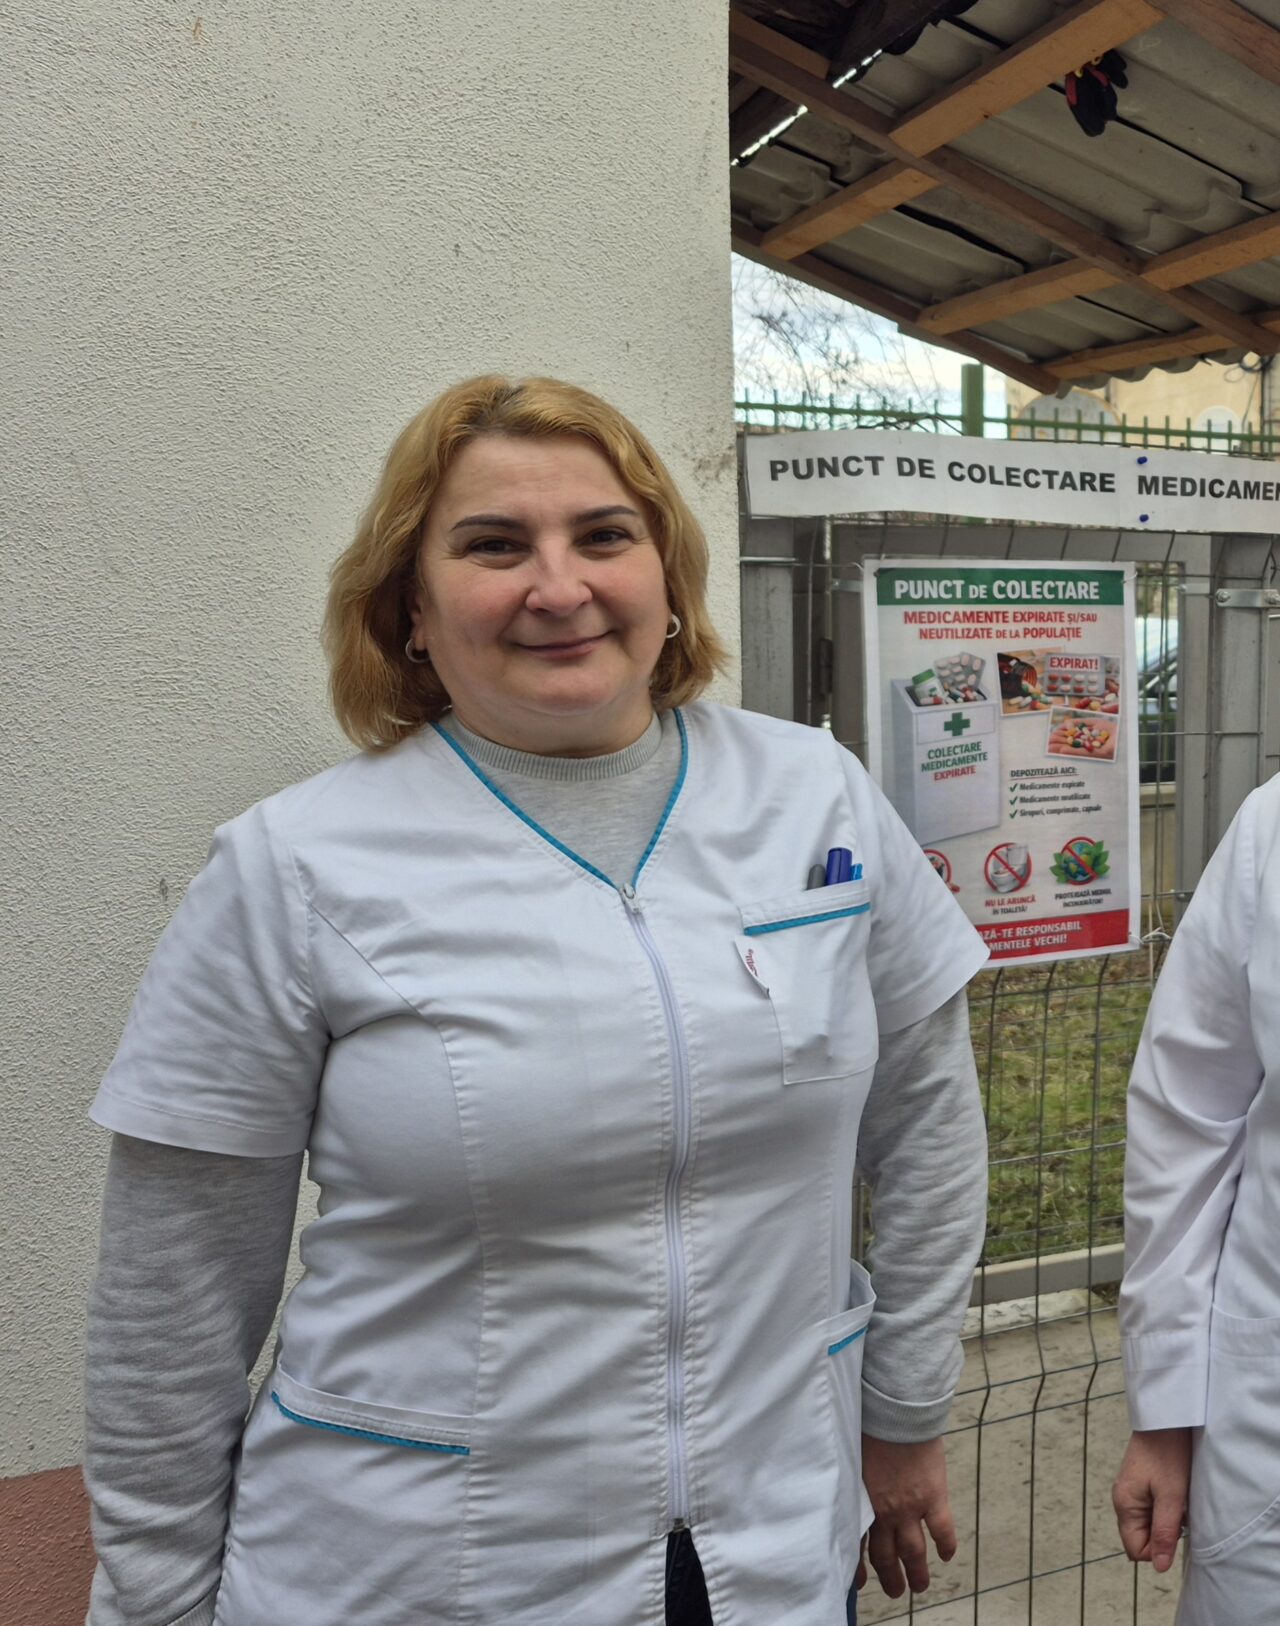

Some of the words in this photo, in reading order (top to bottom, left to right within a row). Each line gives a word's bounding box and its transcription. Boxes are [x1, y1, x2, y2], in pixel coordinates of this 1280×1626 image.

[769, 455, 884, 481] PUNCT
[896, 456, 936, 479] DE
[948, 461, 1116, 493] COLECTARE
[895, 580, 965, 600] PUNCT
[968, 585, 988, 599] DE
[992, 580, 1099, 600] COLECTARE
[904, 611, 1010, 624] MEDICAMENTE
[1012, 612, 1065, 623] EXPIRATE
[919, 628, 993, 640] NEUTILIZATE
[996, 629, 1008, 639] DE
[1009, 630, 1020, 639] LA
[1023, 627, 1082, 642] POPULAȚIE
[1050, 656, 1098, 670] EXPIRAT!
[927, 741, 982, 760] COLECTARE
[921, 751, 988, 773] MEDICAMENTE
[934, 765, 977, 781] EXPIRATE
[1020, 782, 1060, 791] Medicamente
[985, 898, 996, 907] NU
[980, 928, 1013, 941] AZĂ-TE
[1015, 920, 1082, 937] RESPONSABIL
[989, 938, 1032, 952] MENTELE
[1034, 934, 1068, 946] VECHI!
